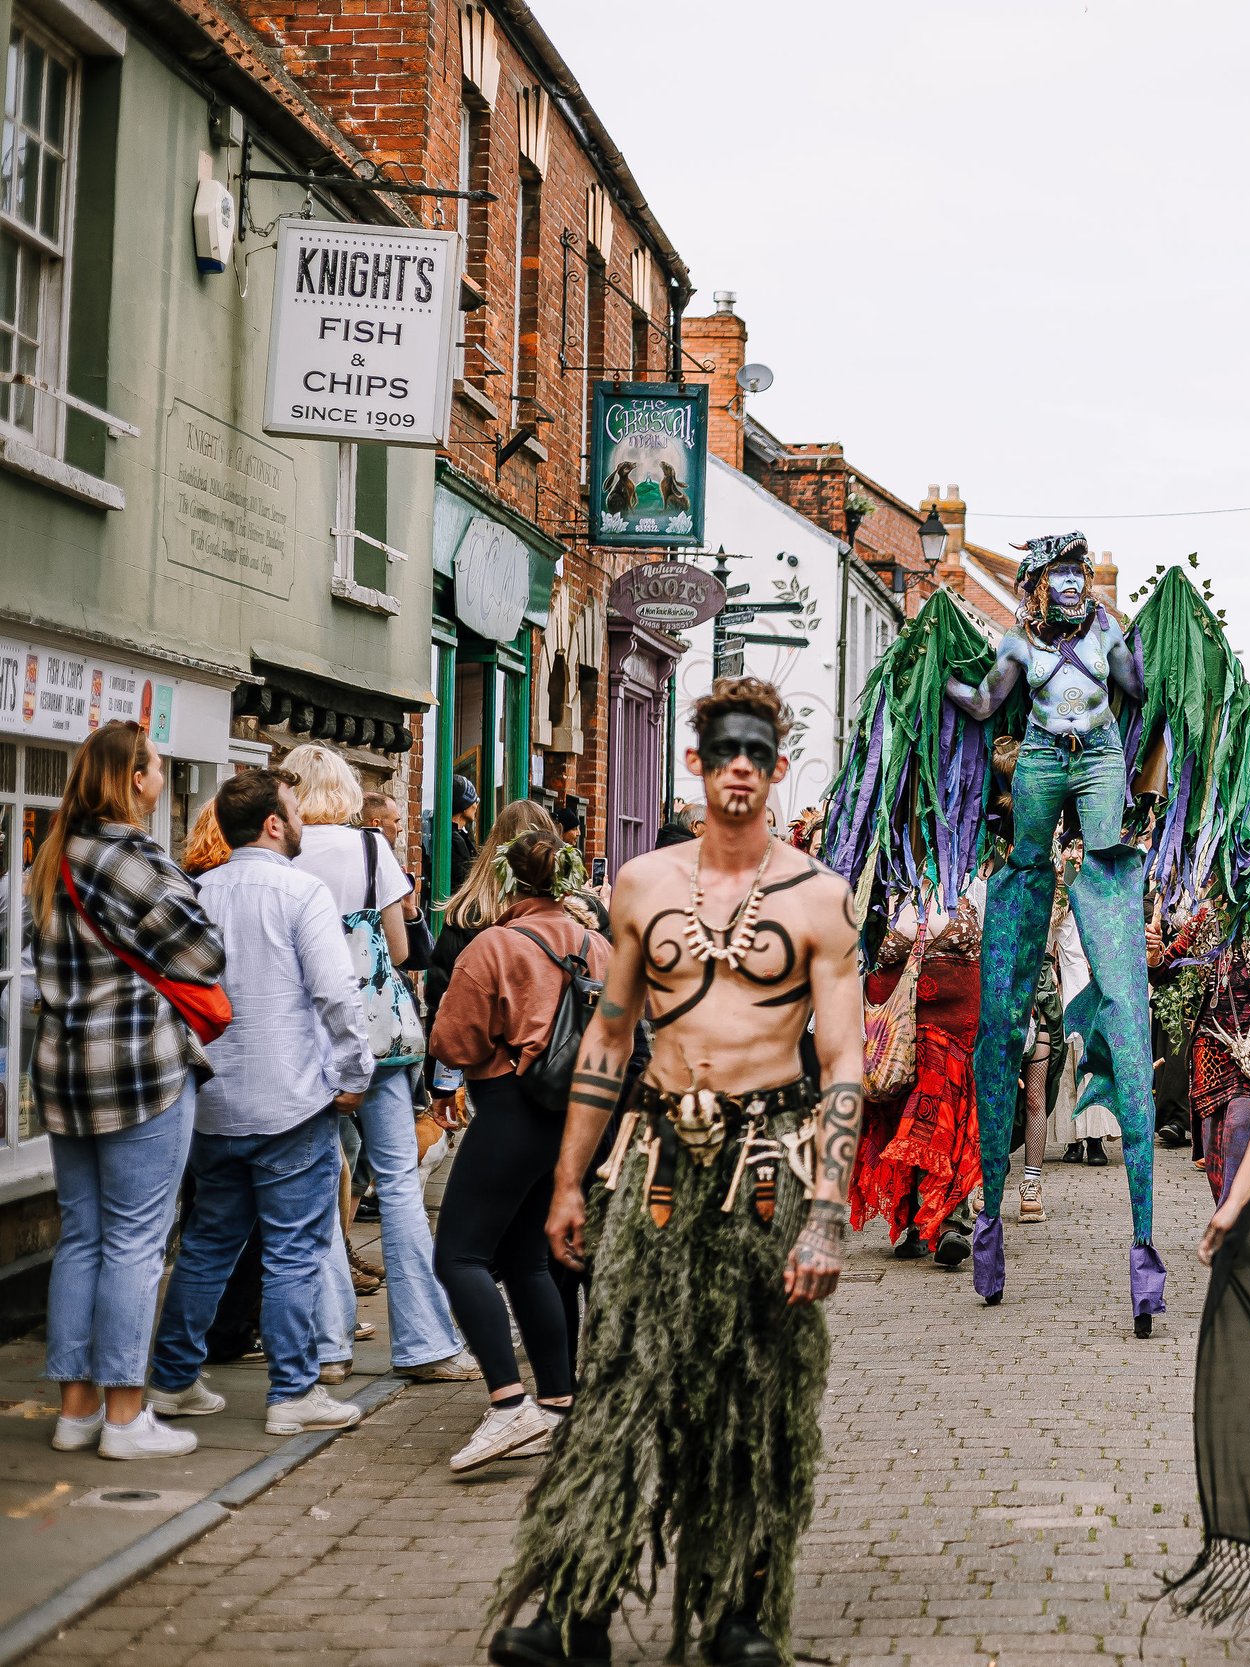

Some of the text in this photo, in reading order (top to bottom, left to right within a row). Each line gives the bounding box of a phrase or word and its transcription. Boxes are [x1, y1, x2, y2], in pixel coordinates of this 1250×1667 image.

[296, 247, 435, 303] KNIGHT'S
[318, 317, 402, 346] FISH
[351, 353, 365, 367] &
[303, 370, 409, 399] CHIPS
[291, 404, 415, 428] SINCE 1909
[641, 563, 688, 578] Natural
[627, 578, 710, 604] ROOTS
[640, 606, 646, 615] A
[679, 607, 694, 616] Salon
[46, 656, 60, 686] FISH
[67, 661, 84, 690] CHIPS
